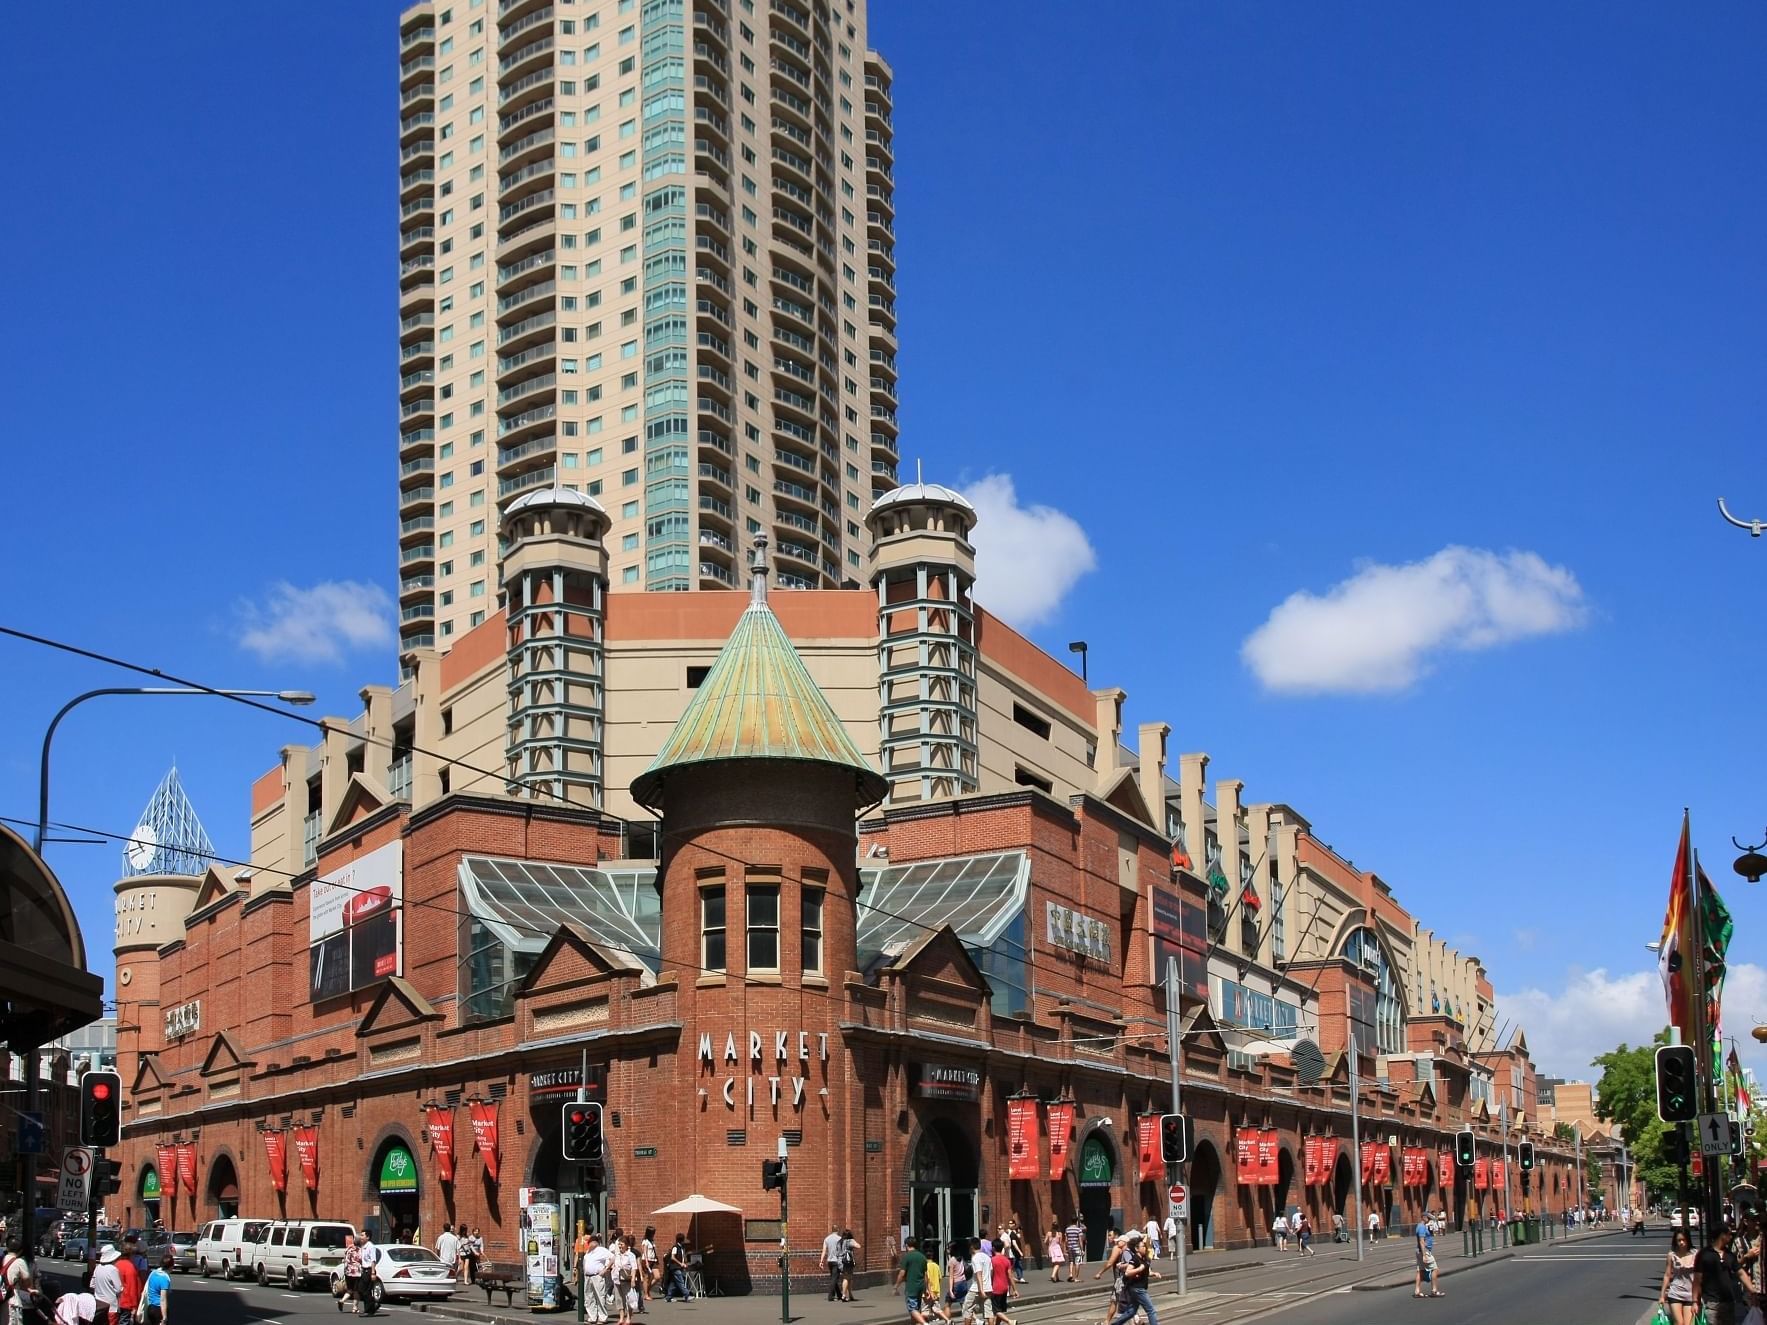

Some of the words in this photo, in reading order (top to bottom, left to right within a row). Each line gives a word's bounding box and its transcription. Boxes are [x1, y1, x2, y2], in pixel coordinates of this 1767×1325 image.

[312, 887, 324, 899] Take
[698, 1031, 829, 1060] MARKET
[558, 1070, 580, 1084] CITY
[937, 1068, 966, 1083] MARKET
[723, 1077, 804, 1105] CITY
[1704, 1142, 1729, 1152] ONLY
[66, 1179, 82, 1188] NO
[62, 1190, 84, 1198] LEFT
[60, 1198, 83, 1208] TURN
